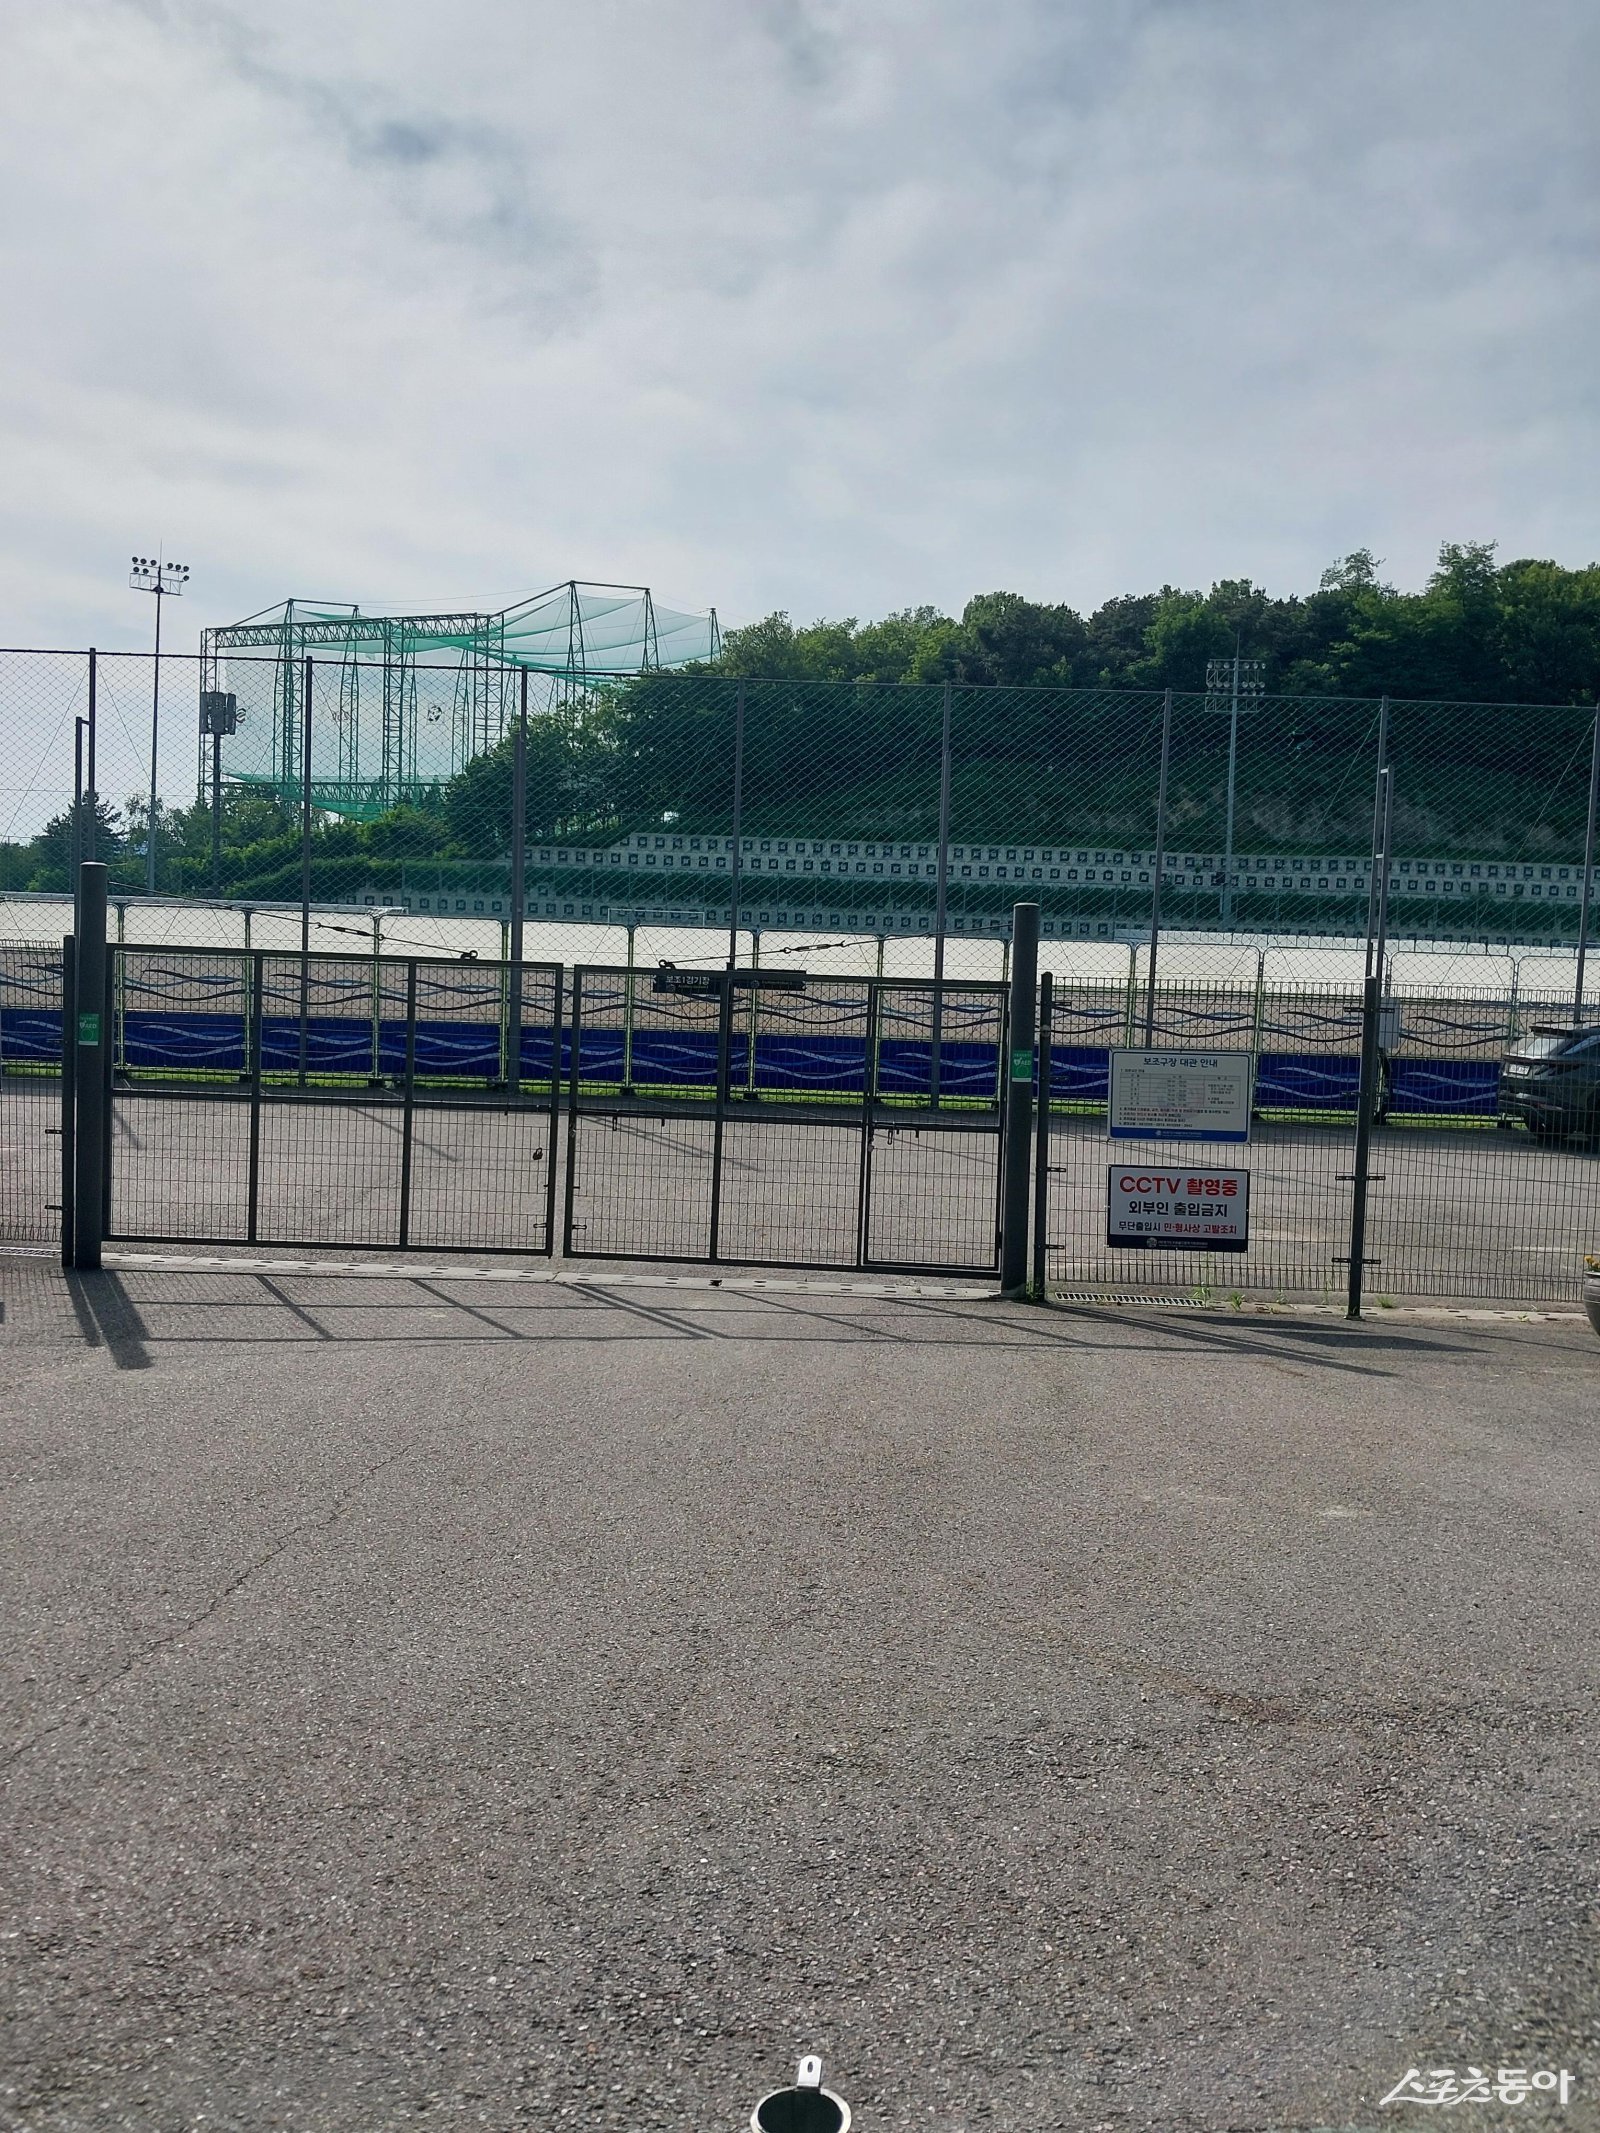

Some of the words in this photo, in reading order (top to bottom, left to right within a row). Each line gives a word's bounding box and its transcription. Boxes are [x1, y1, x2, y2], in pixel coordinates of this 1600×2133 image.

[1143, 1057, 1177, 1067] 보조구장
[1180, 1059, 1197, 1068] 대관
[1200, 1059, 1218, 1068] 안내
[1119, 1176, 1181, 1194] CCTV
[1186, 1178, 1238, 1197] 촬영중
[1128, 1200, 1169, 1216] 외부인
[1173, 1202, 1228, 1218] 출입금지
[1119, 1221, 1160, 1232] 무단출입시
[1203, 1225, 1237, 1235] 고발조치
